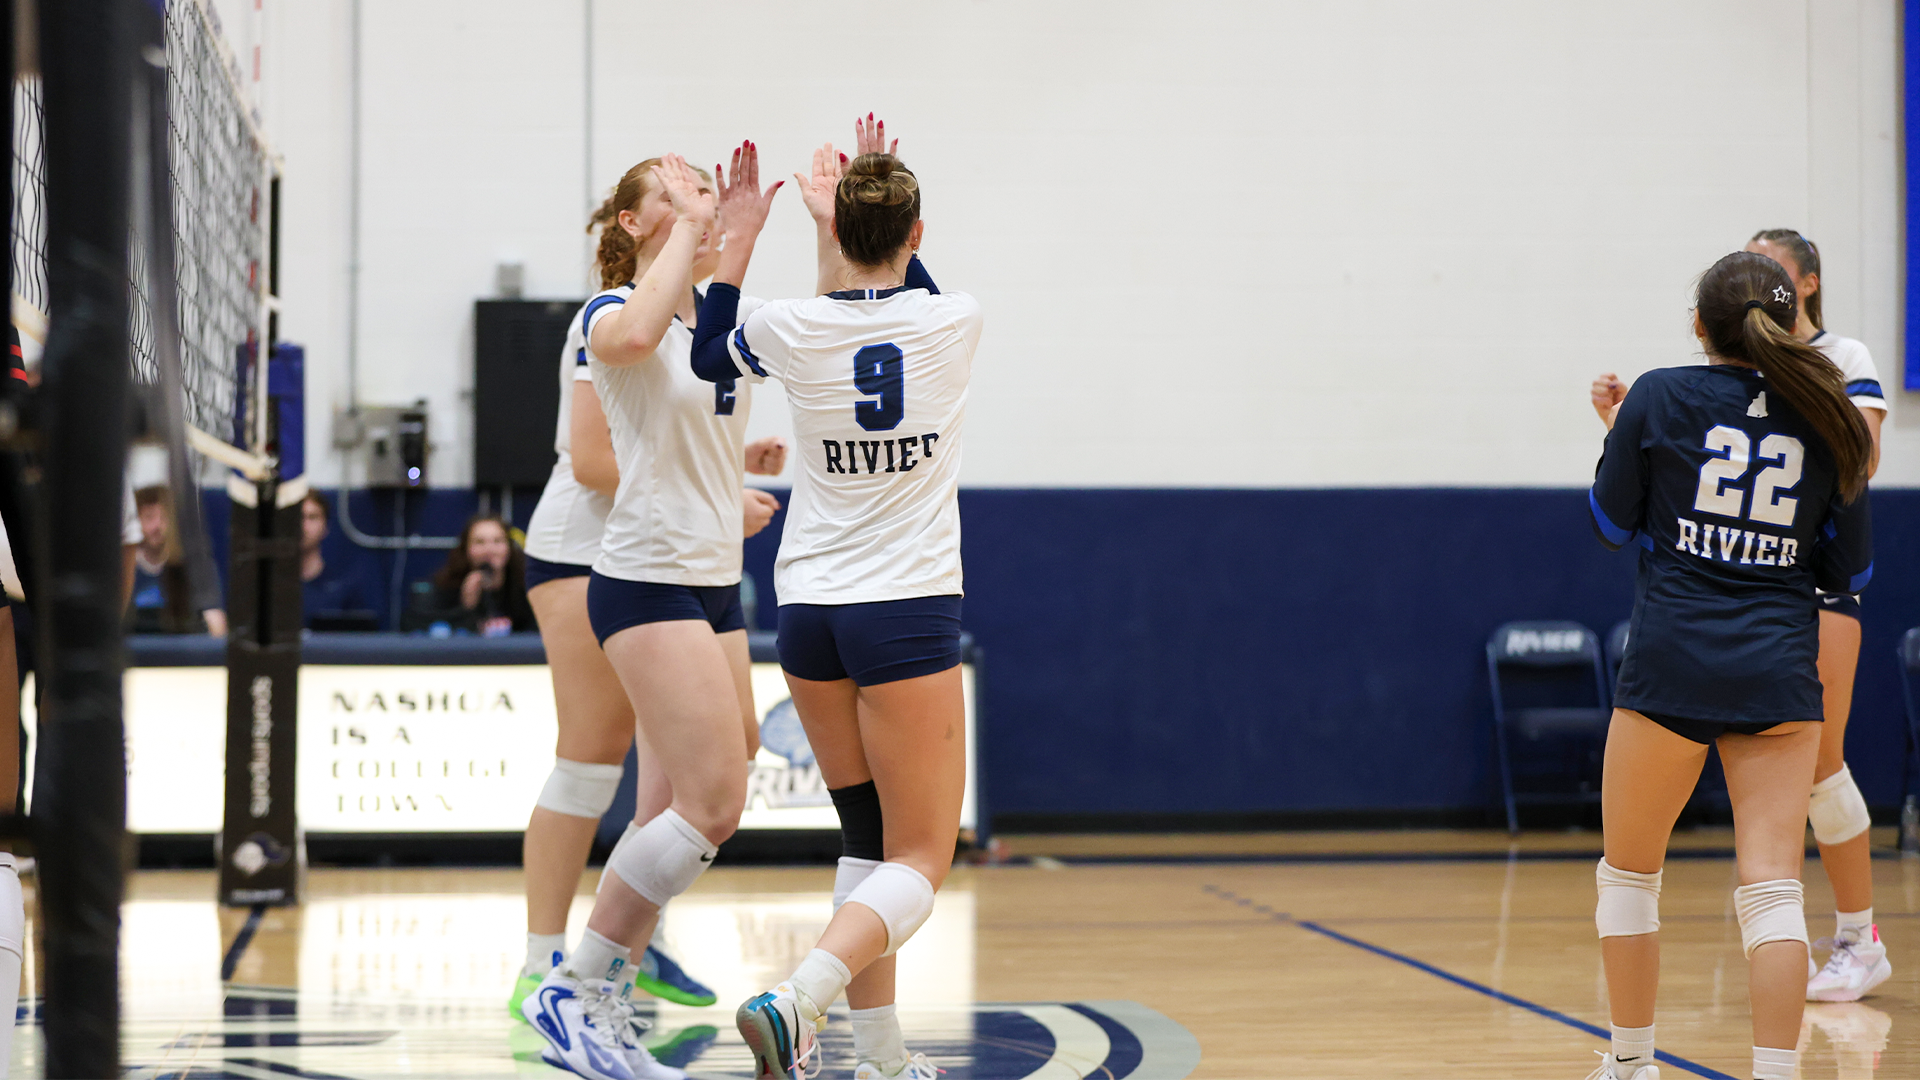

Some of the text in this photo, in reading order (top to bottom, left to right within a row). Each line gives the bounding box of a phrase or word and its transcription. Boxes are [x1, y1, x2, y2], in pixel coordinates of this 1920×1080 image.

[853, 342, 904, 431] 9
[1692, 423, 1805, 528] 22
[1675, 517, 1798, 567] RIVIER
[332, 692, 515, 711] NASHUA
[333, 726, 411, 744] IS A
